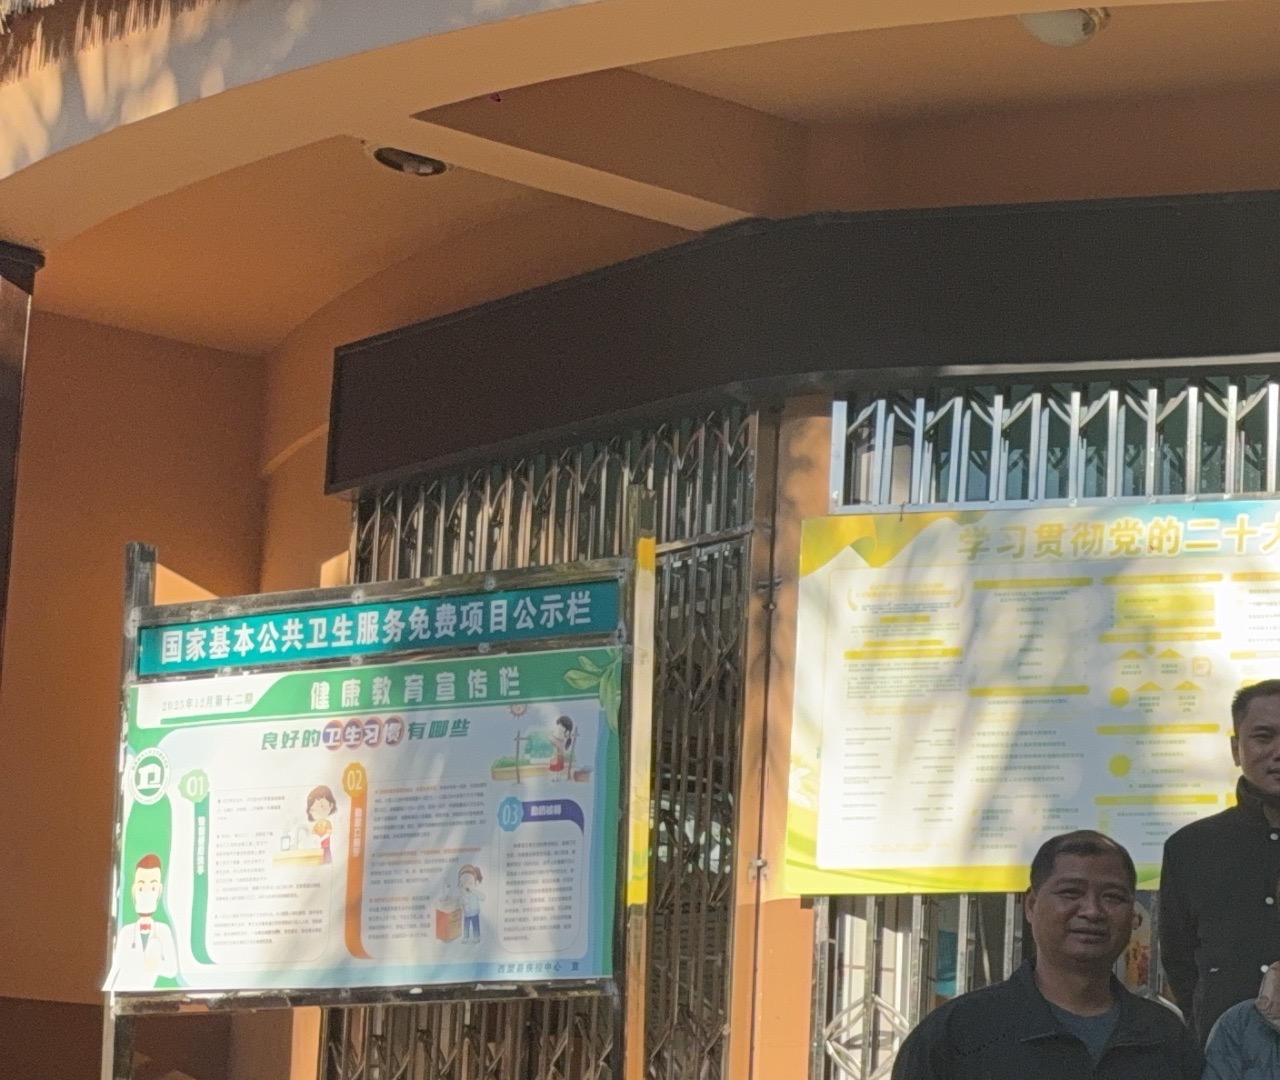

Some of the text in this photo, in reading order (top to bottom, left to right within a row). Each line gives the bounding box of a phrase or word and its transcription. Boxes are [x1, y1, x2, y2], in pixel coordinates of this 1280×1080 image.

[161, 590, 592, 664] 国家基本公共卫生服务免费项目公示栏
[310, 665, 521, 710] 健康教育宣传栏
[261, 718, 471, 751] 良好的卫生习惯有哪些
[186, 776, 205, 797] 01
[346, 769, 363, 791] 02
[502, 804, 518, 826] 03
